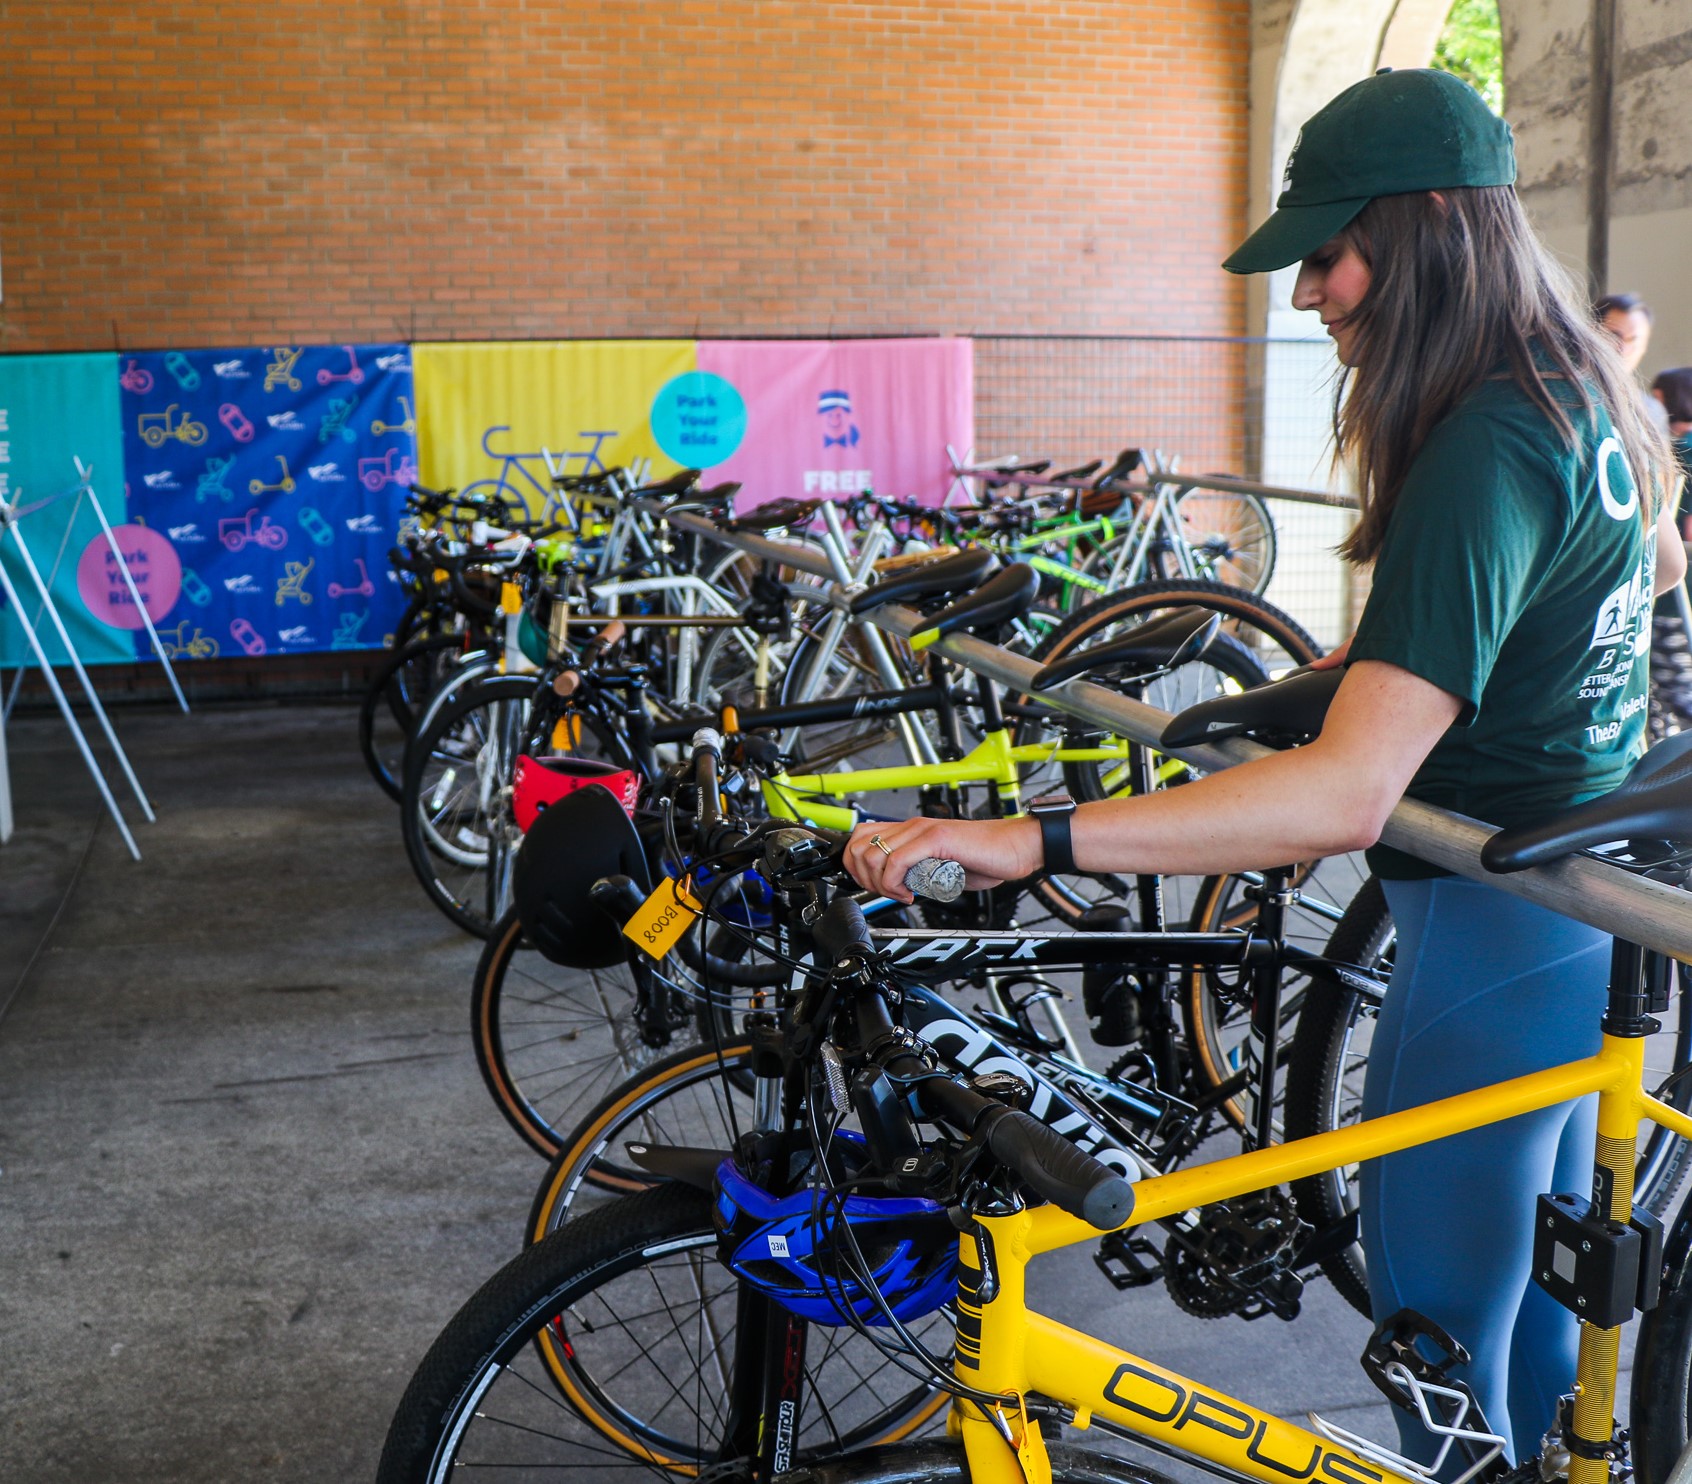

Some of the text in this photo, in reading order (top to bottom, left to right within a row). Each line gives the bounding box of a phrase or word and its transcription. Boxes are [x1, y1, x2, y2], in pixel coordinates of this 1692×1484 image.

[804, 470, 872, 492] FREE
[1577, 687, 1608, 699] SOUN
[643, 905, 679, 944] B008
[770, 1241, 786, 1251] MEC
[1102, 1363, 1383, 1484] OPUS
